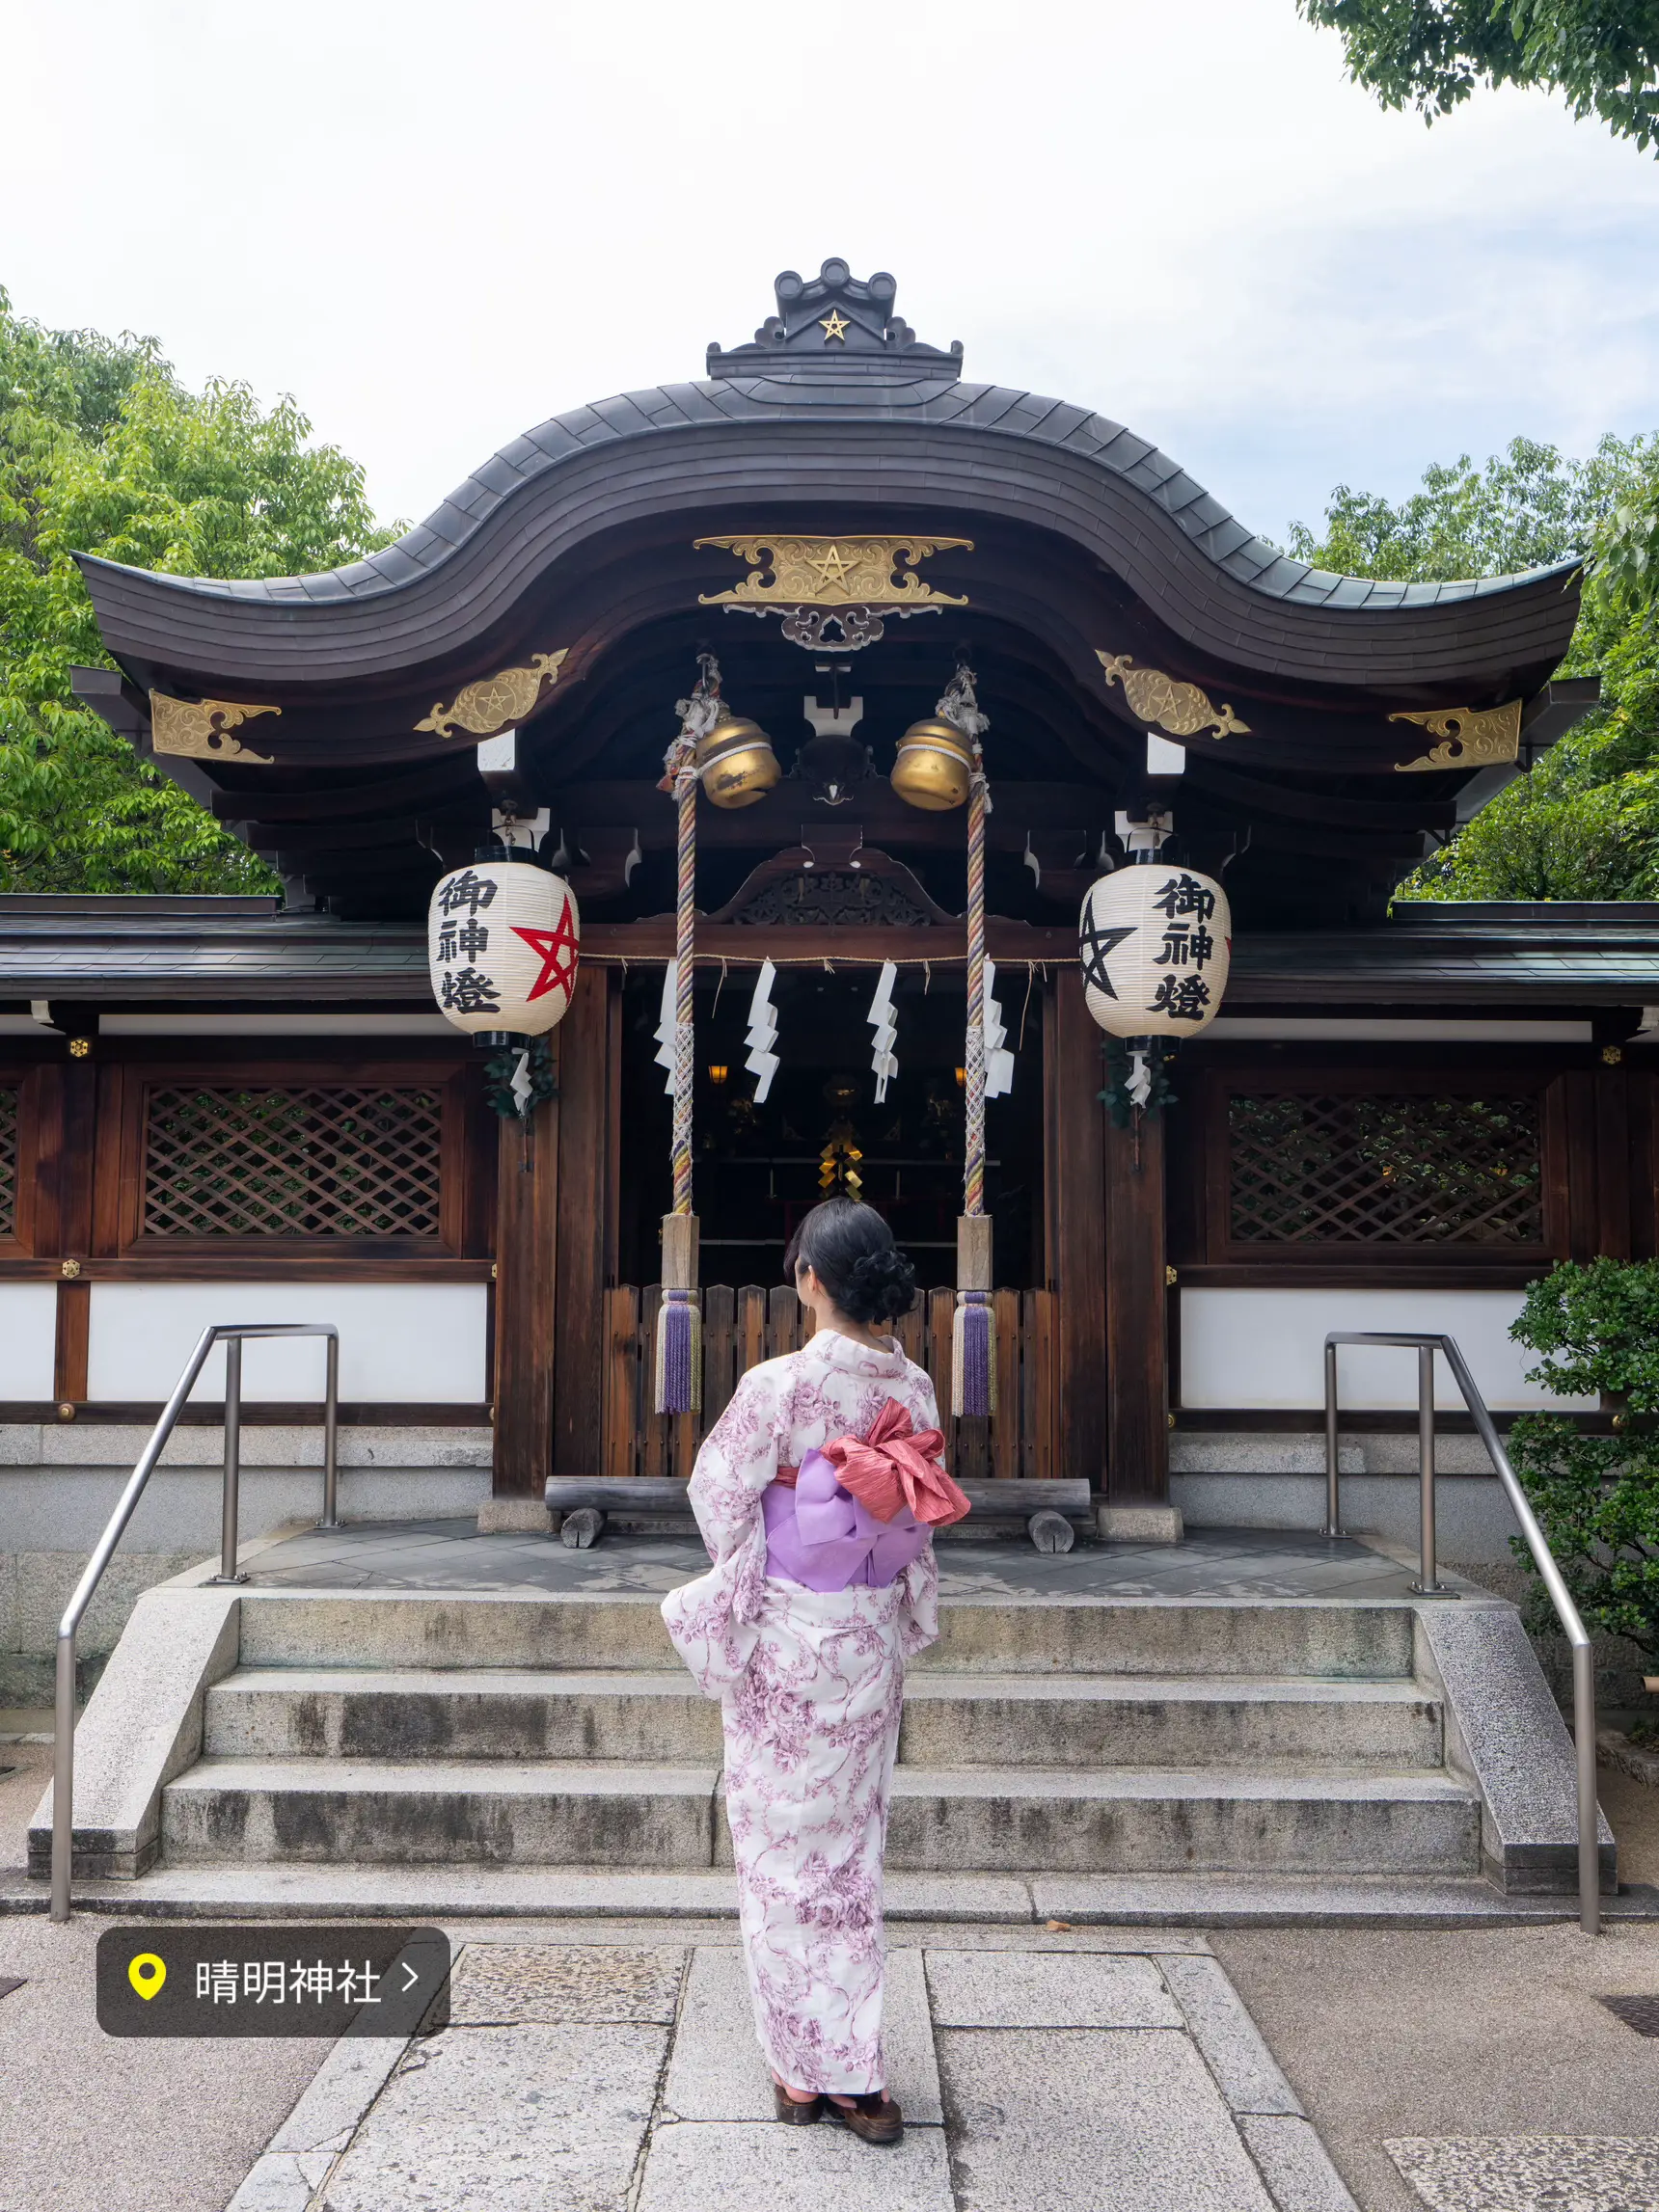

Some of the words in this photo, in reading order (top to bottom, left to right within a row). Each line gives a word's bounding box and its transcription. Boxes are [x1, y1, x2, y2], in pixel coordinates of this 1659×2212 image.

[436, 870, 502, 1014] 御神燈
[1145, 873, 1215, 1021] 御神燈
